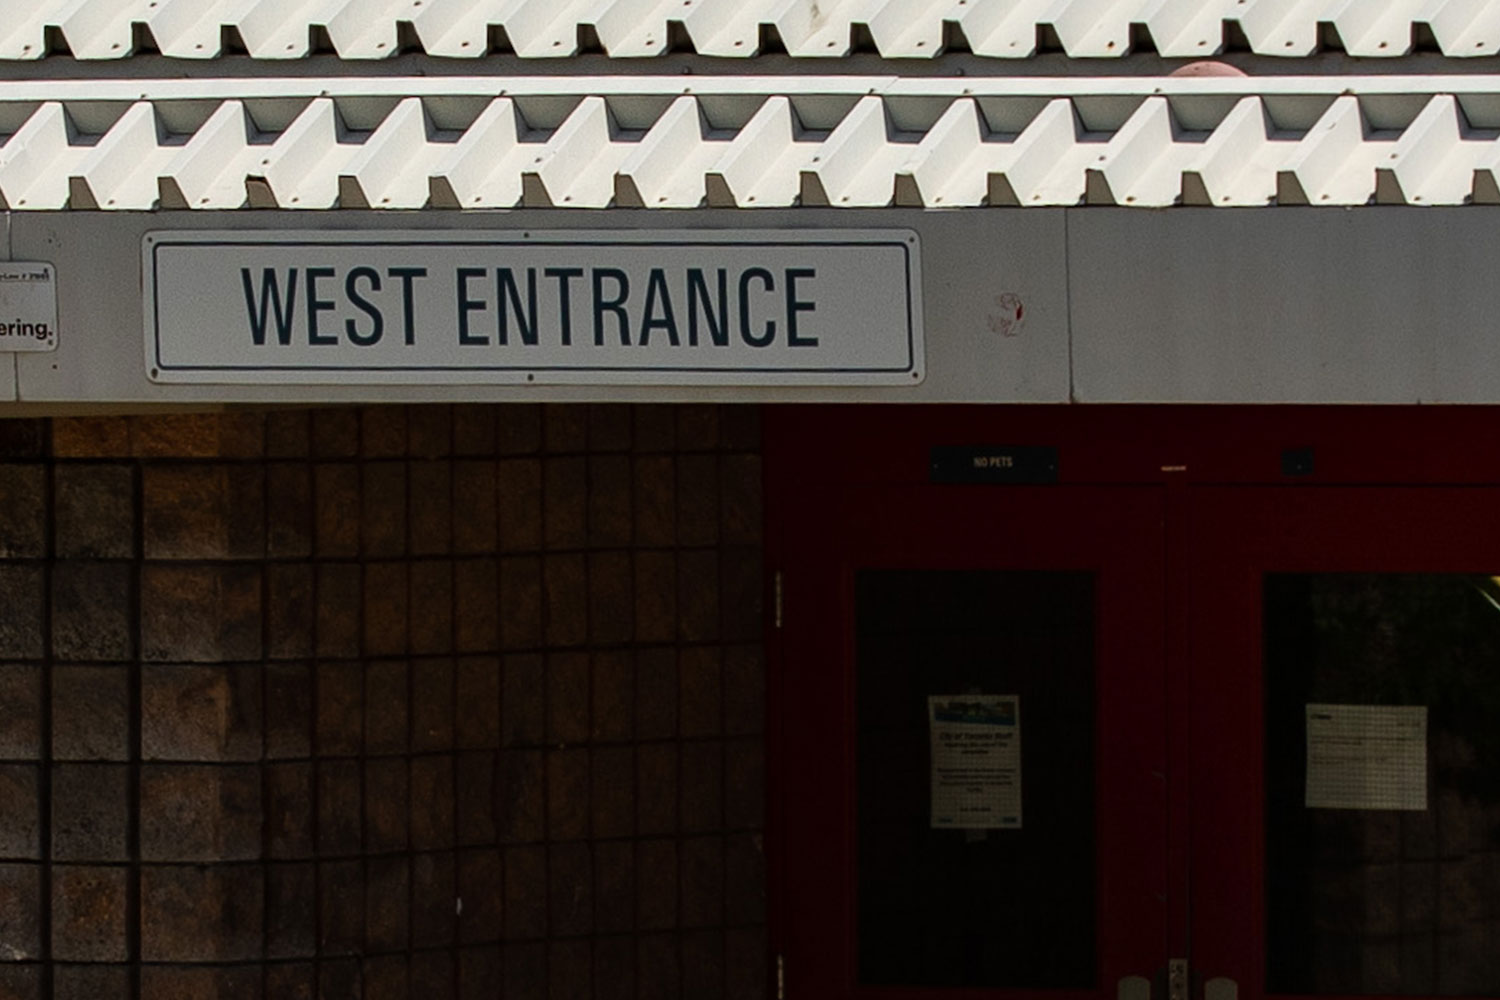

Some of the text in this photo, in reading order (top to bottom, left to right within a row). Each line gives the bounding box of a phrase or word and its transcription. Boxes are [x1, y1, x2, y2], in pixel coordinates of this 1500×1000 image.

[240, 266, 820, 348] WEST ENTRANCE
[973, 456, 1014, 468] NO PETS
